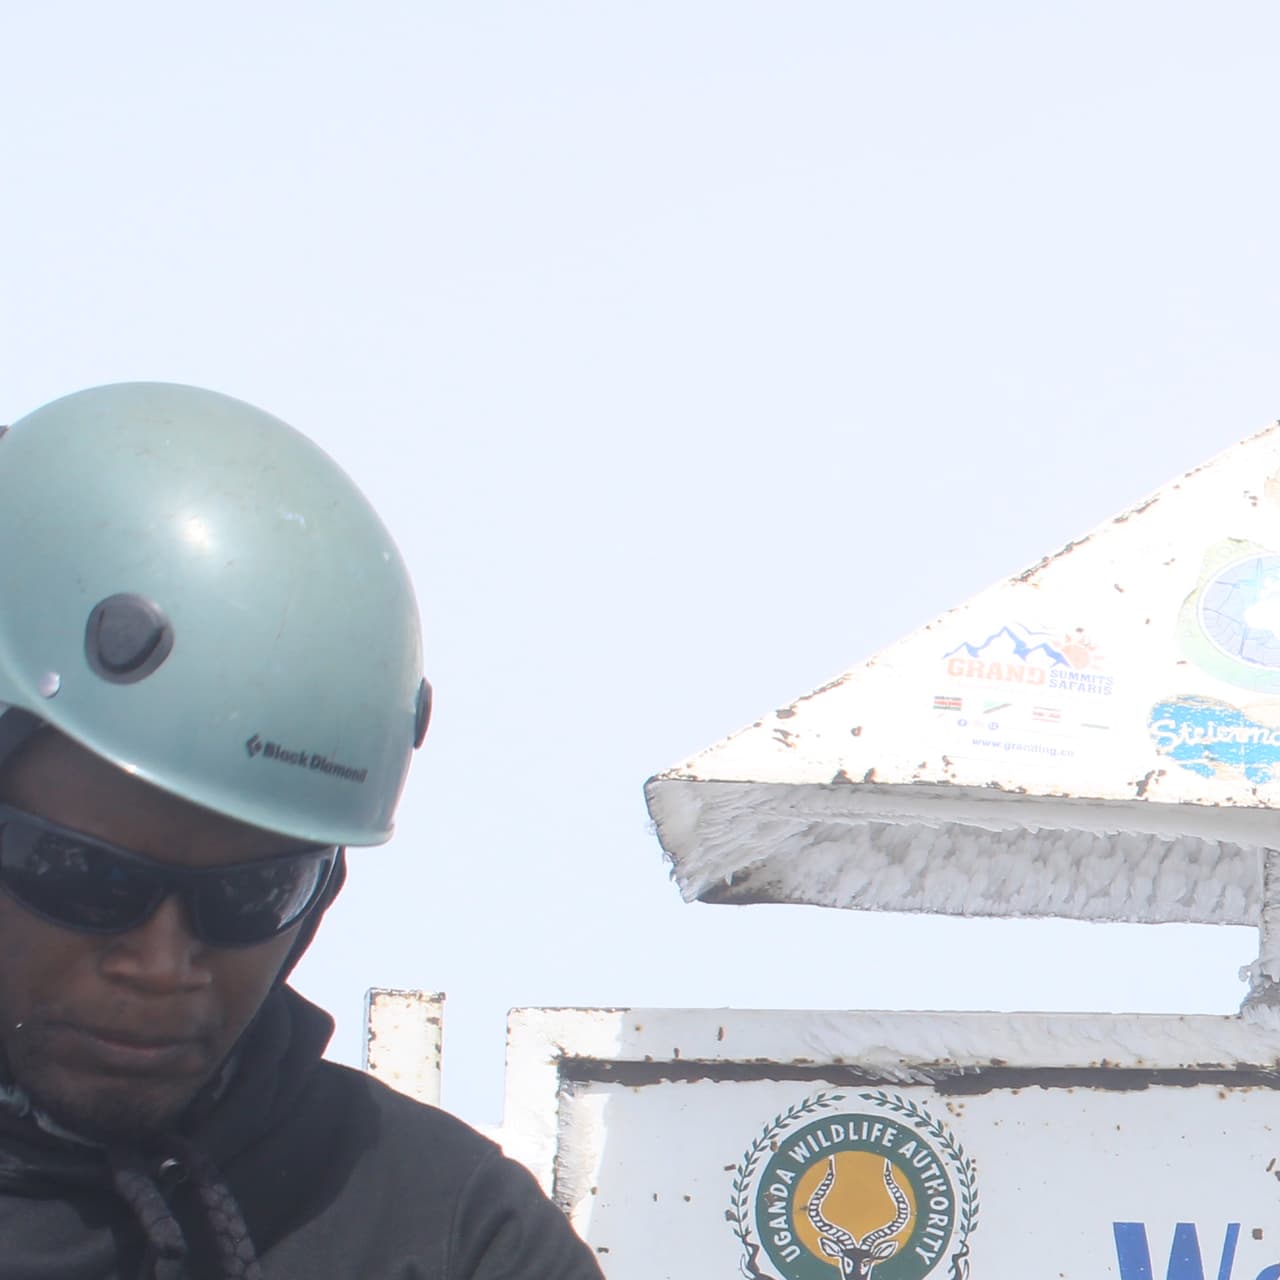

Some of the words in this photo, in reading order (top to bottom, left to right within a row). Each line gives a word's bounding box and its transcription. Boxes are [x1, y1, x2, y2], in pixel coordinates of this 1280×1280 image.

[946, 656, 1046, 686] GRAND
[1050, 669, 1114, 686] SUMMITS
[1049, 678, 1112, 696] SAFARIS
[262, 741, 309, 767] Black
[309, 753, 368, 784] Diamond
[767, 1168, 800, 1263] UGANDA
[788, 1120, 899, 1163] WILDLIFE
[898, 1138, 949, 1265] AUTHORITY
